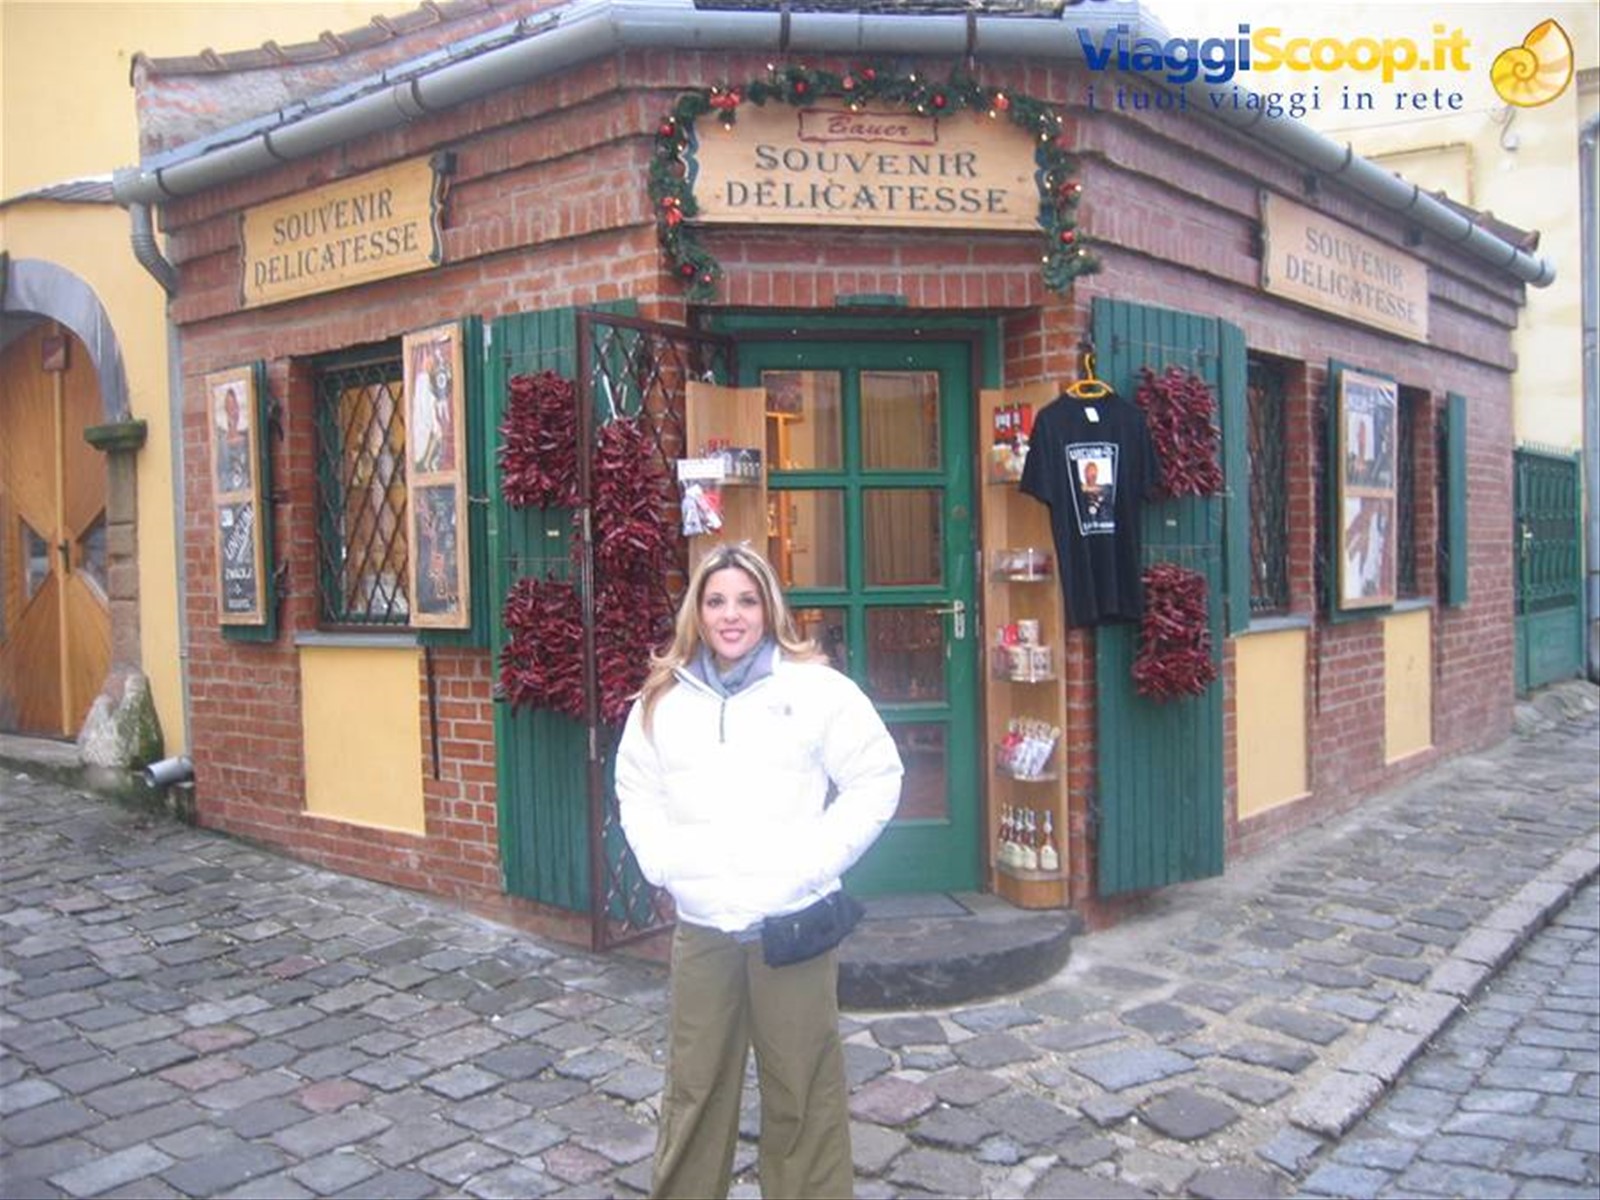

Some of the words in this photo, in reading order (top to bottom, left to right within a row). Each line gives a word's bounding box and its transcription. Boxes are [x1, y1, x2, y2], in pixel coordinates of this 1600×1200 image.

[826, 115, 909, 138] Bauer
[755, 145, 977, 178] SOUVENIR
[272, 188, 393, 246] SOUVENIR
[726, 181, 1008, 213] DELICATESSE
[254, 222, 418, 288] DELICATESSE
[1306, 226, 1404, 290] SOUVENIR
[1286, 254, 1417, 323] DELICATESSE
